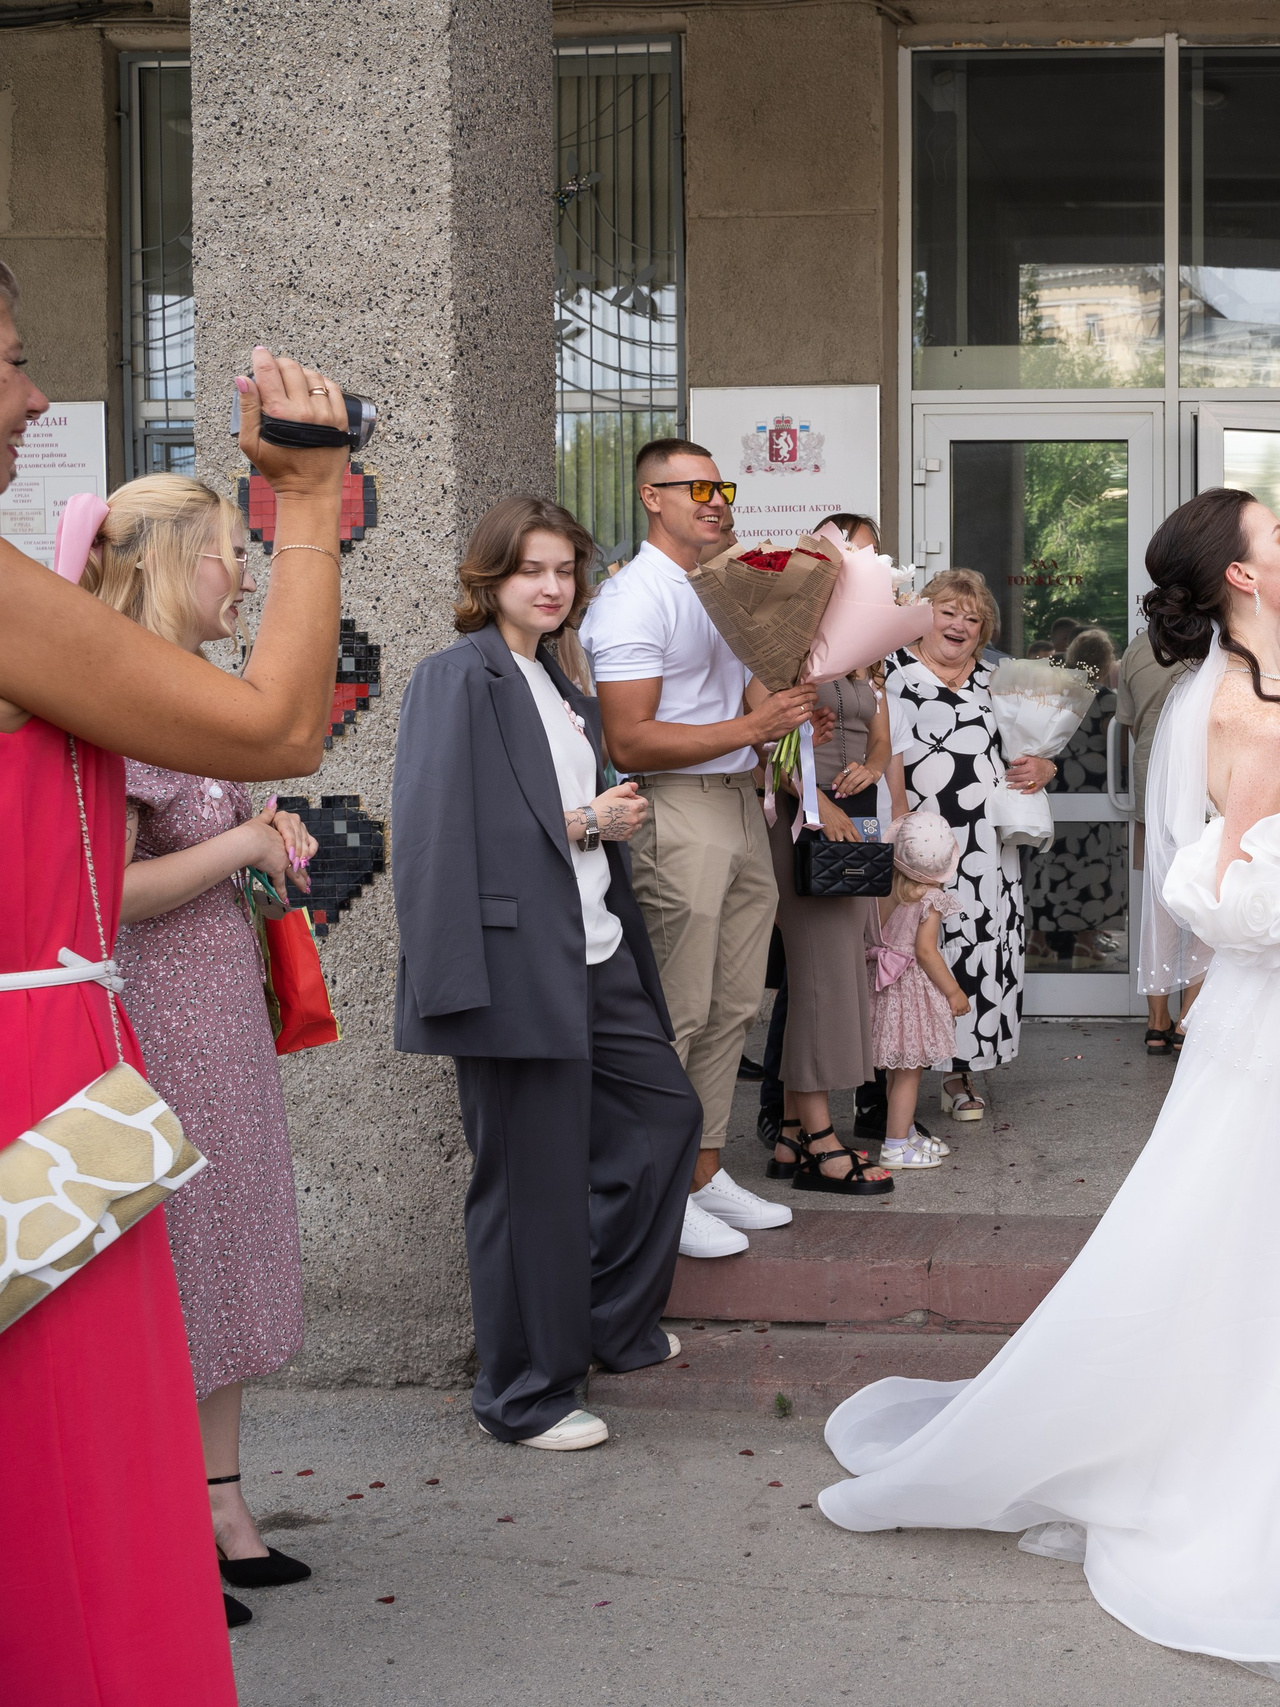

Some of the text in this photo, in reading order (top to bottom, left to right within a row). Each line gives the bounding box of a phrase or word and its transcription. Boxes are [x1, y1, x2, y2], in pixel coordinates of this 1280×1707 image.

[41, 452, 67, 460] района
[764, 504, 806, 513] ЗАПИСИ
[808, 504, 842, 512] АКТОВ
[1031, 559, 1059, 570] ЗАЛ
[1005, 575, 1084, 586] ТОРЖЕСТВ
